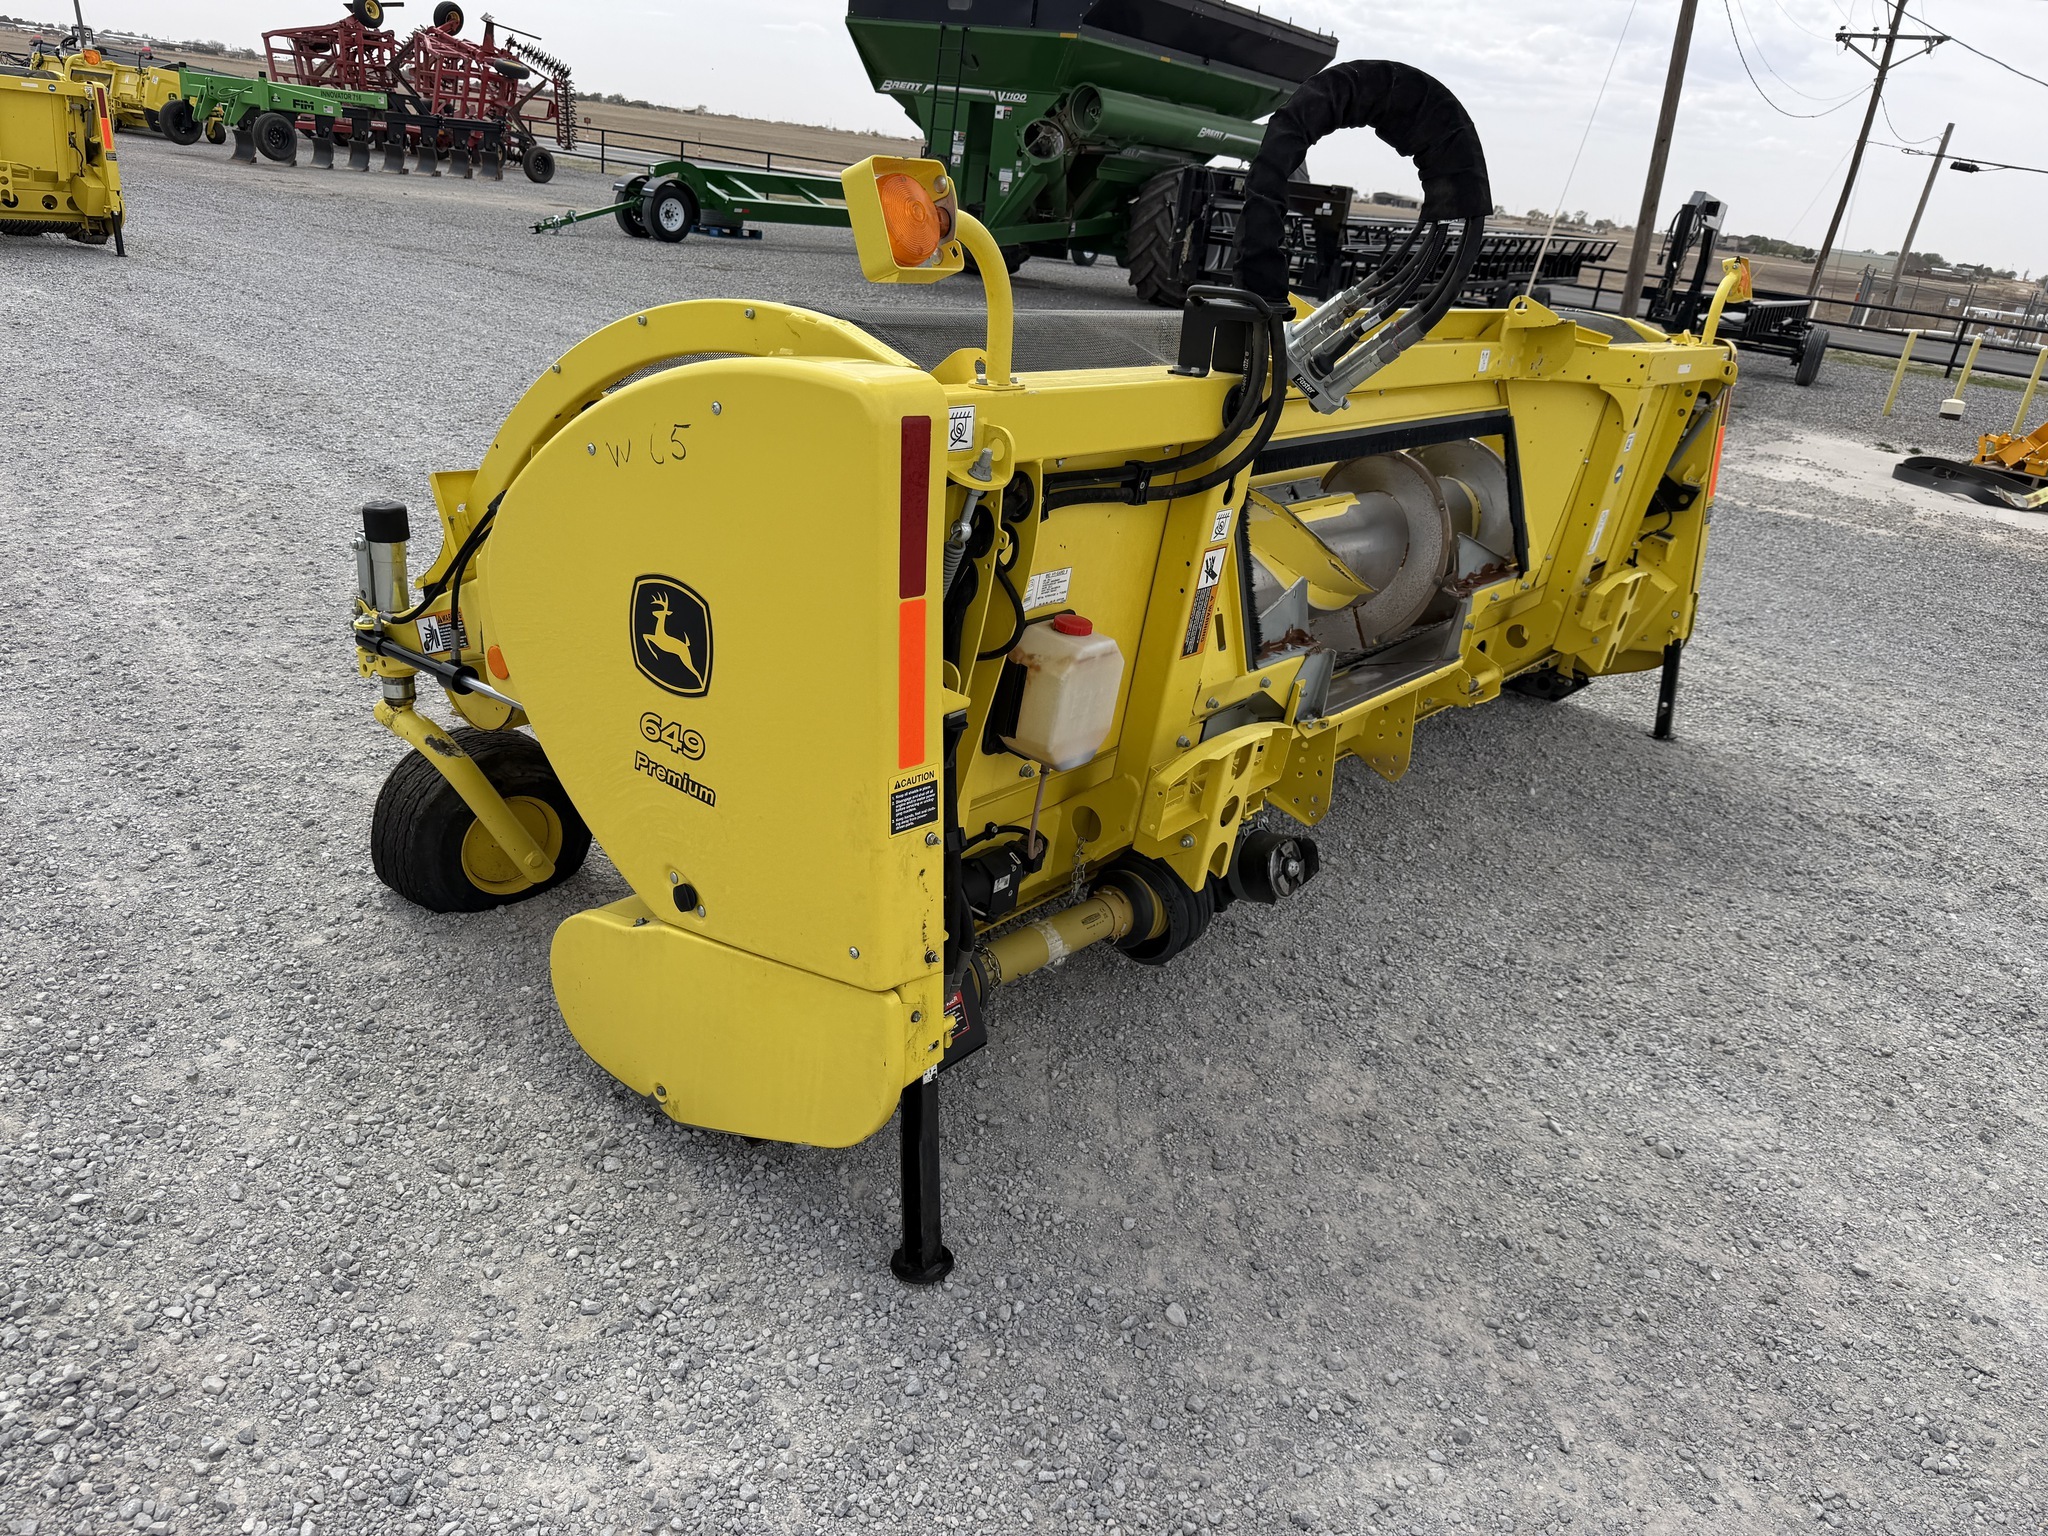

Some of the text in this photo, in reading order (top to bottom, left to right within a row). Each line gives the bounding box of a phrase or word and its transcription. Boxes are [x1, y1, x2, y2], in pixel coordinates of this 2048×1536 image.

[880, 80, 922, 93] BRENT
[320, 90, 352, 101] INNOVATOR
[292, 98, 315, 111] FIM
[1197, 127, 1224, 140] BRENT
[1296, 376, 1316, 393] Foster
[606, 438, 631, 468] W
[1201, 604, 1214, 643] WARNING
[640, 711, 706, 761] 649
[634, 750, 716, 808] Premium
[900, 770, 935, 788] CAUTION
